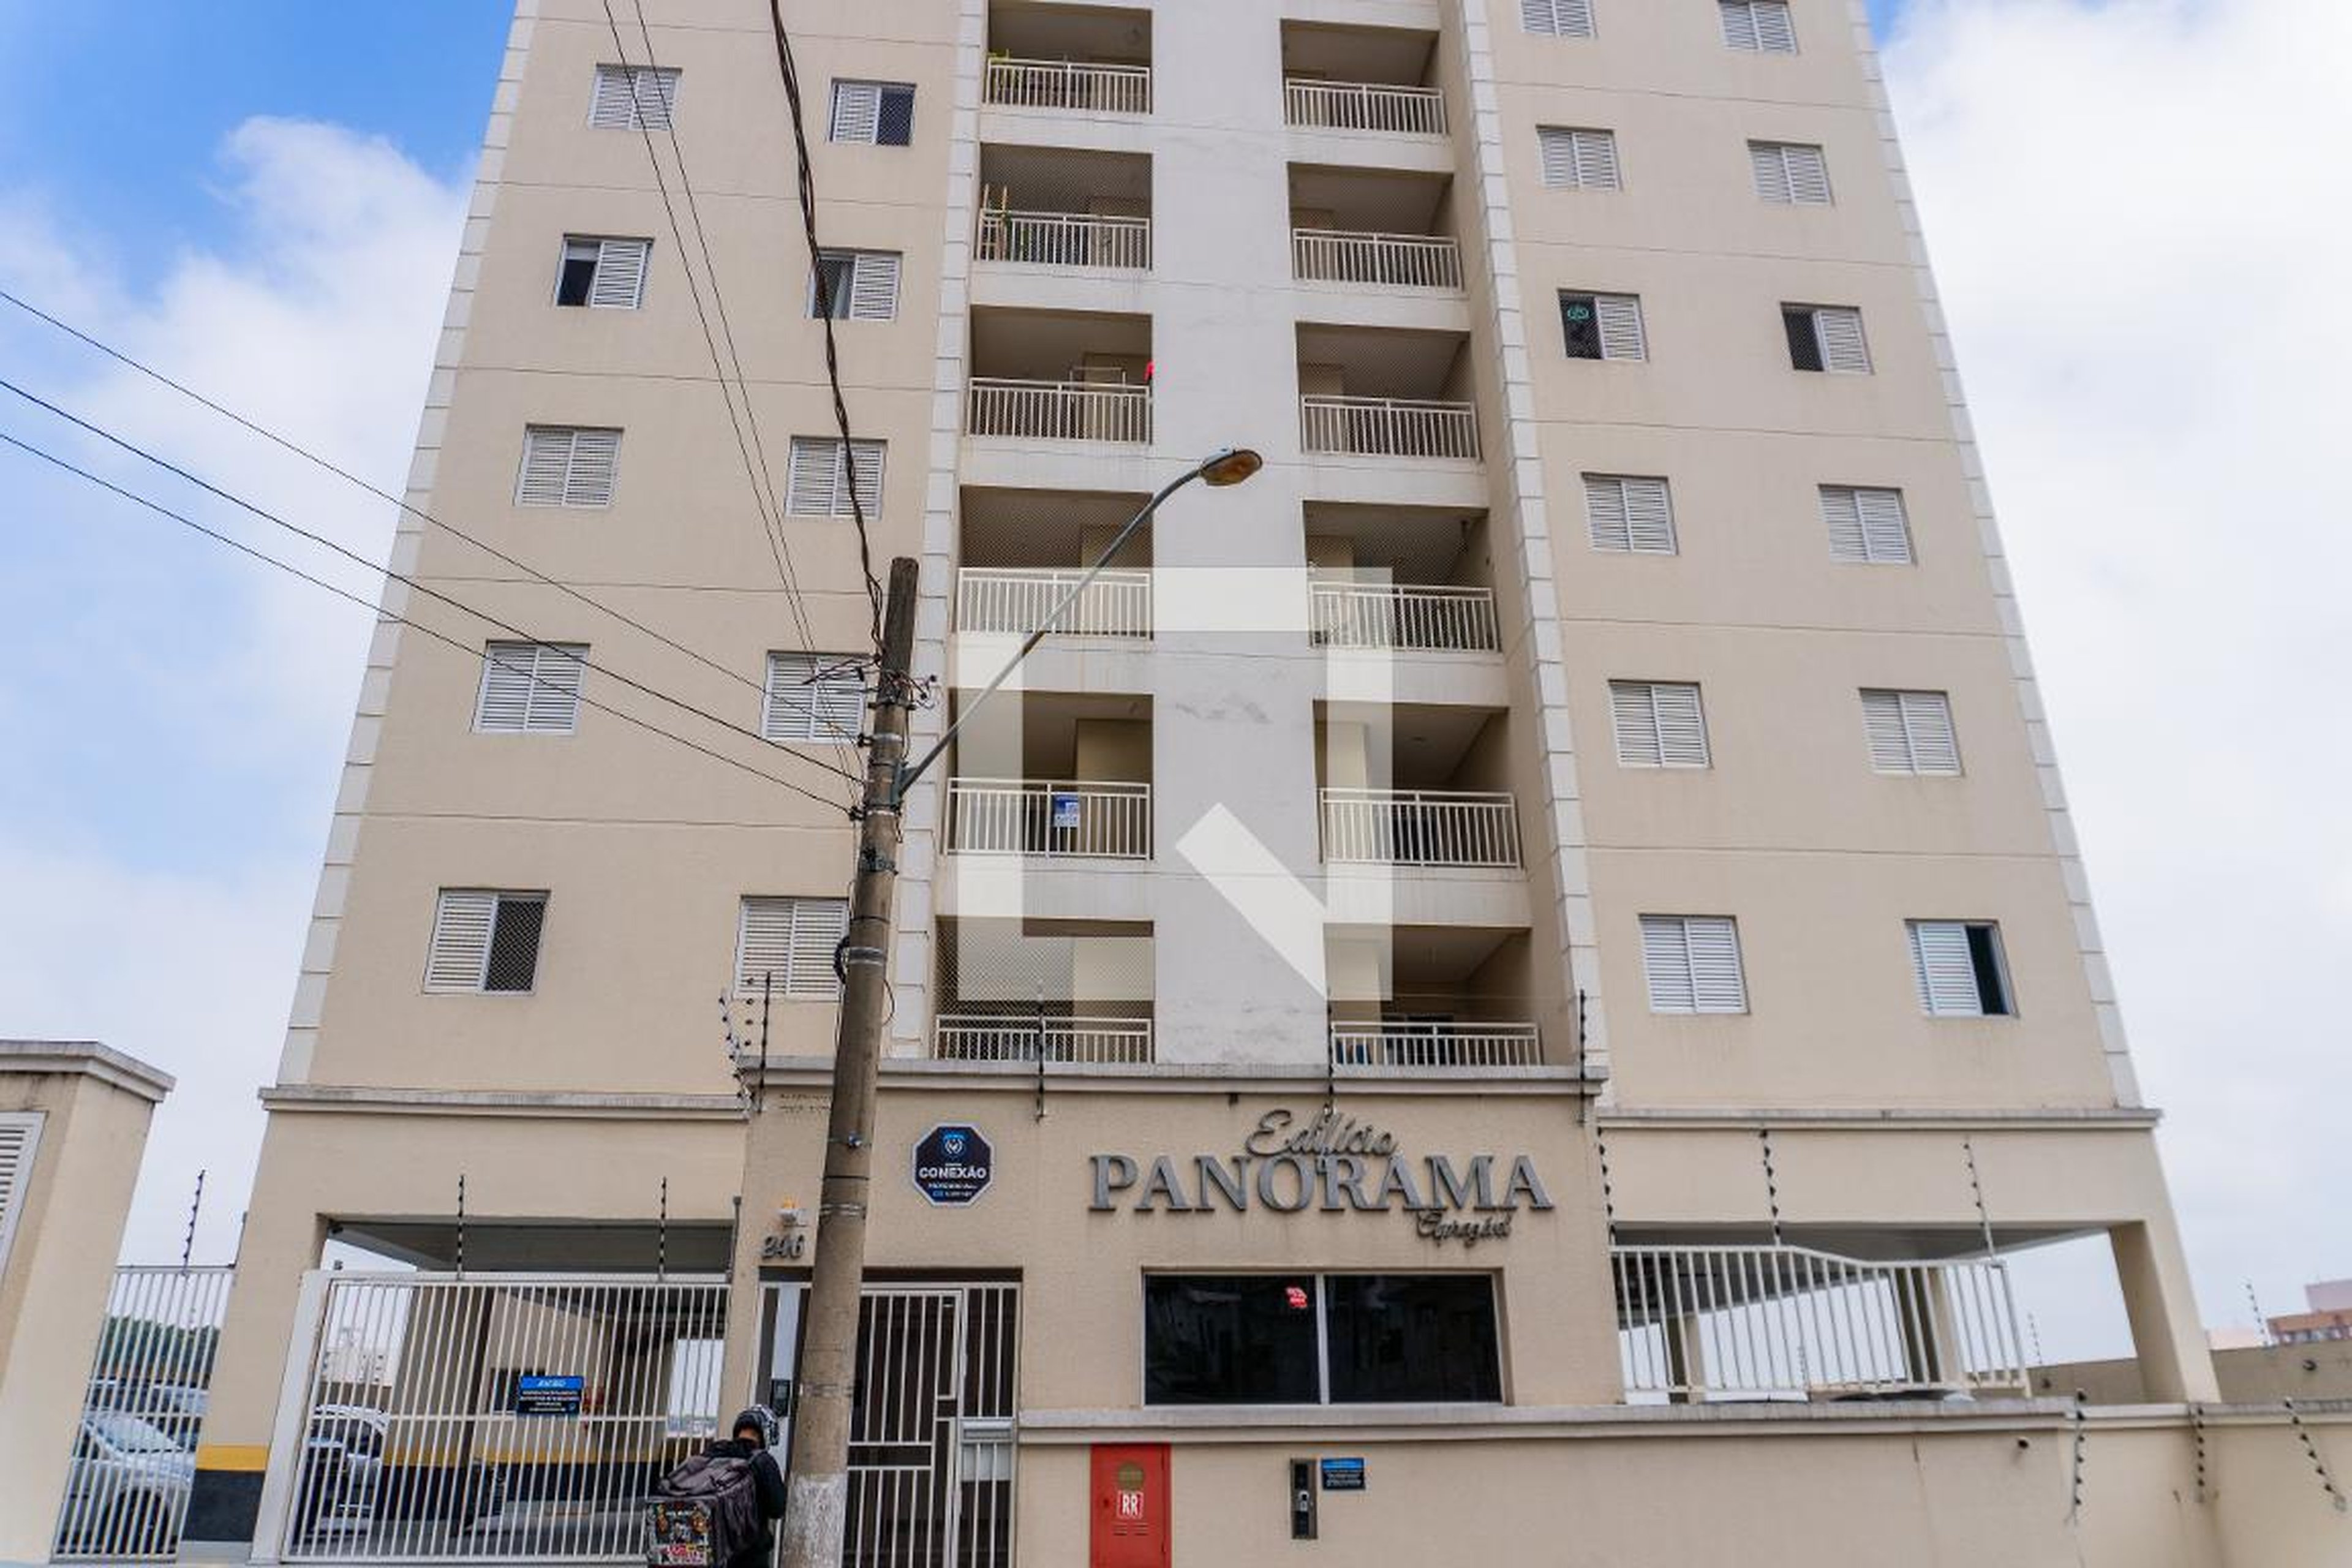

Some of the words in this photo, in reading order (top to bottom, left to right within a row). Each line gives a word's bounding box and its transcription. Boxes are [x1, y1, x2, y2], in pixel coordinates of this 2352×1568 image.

[1246, 1109, 1398, 1158] Edifício
[919, 1166, 987, 1179] CONEXÃO
[1088, 1154, 1555, 1213] PANORAMA
[761, 1234, 805, 1259] 246
[1121, 1494, 1139, 1515] RR
